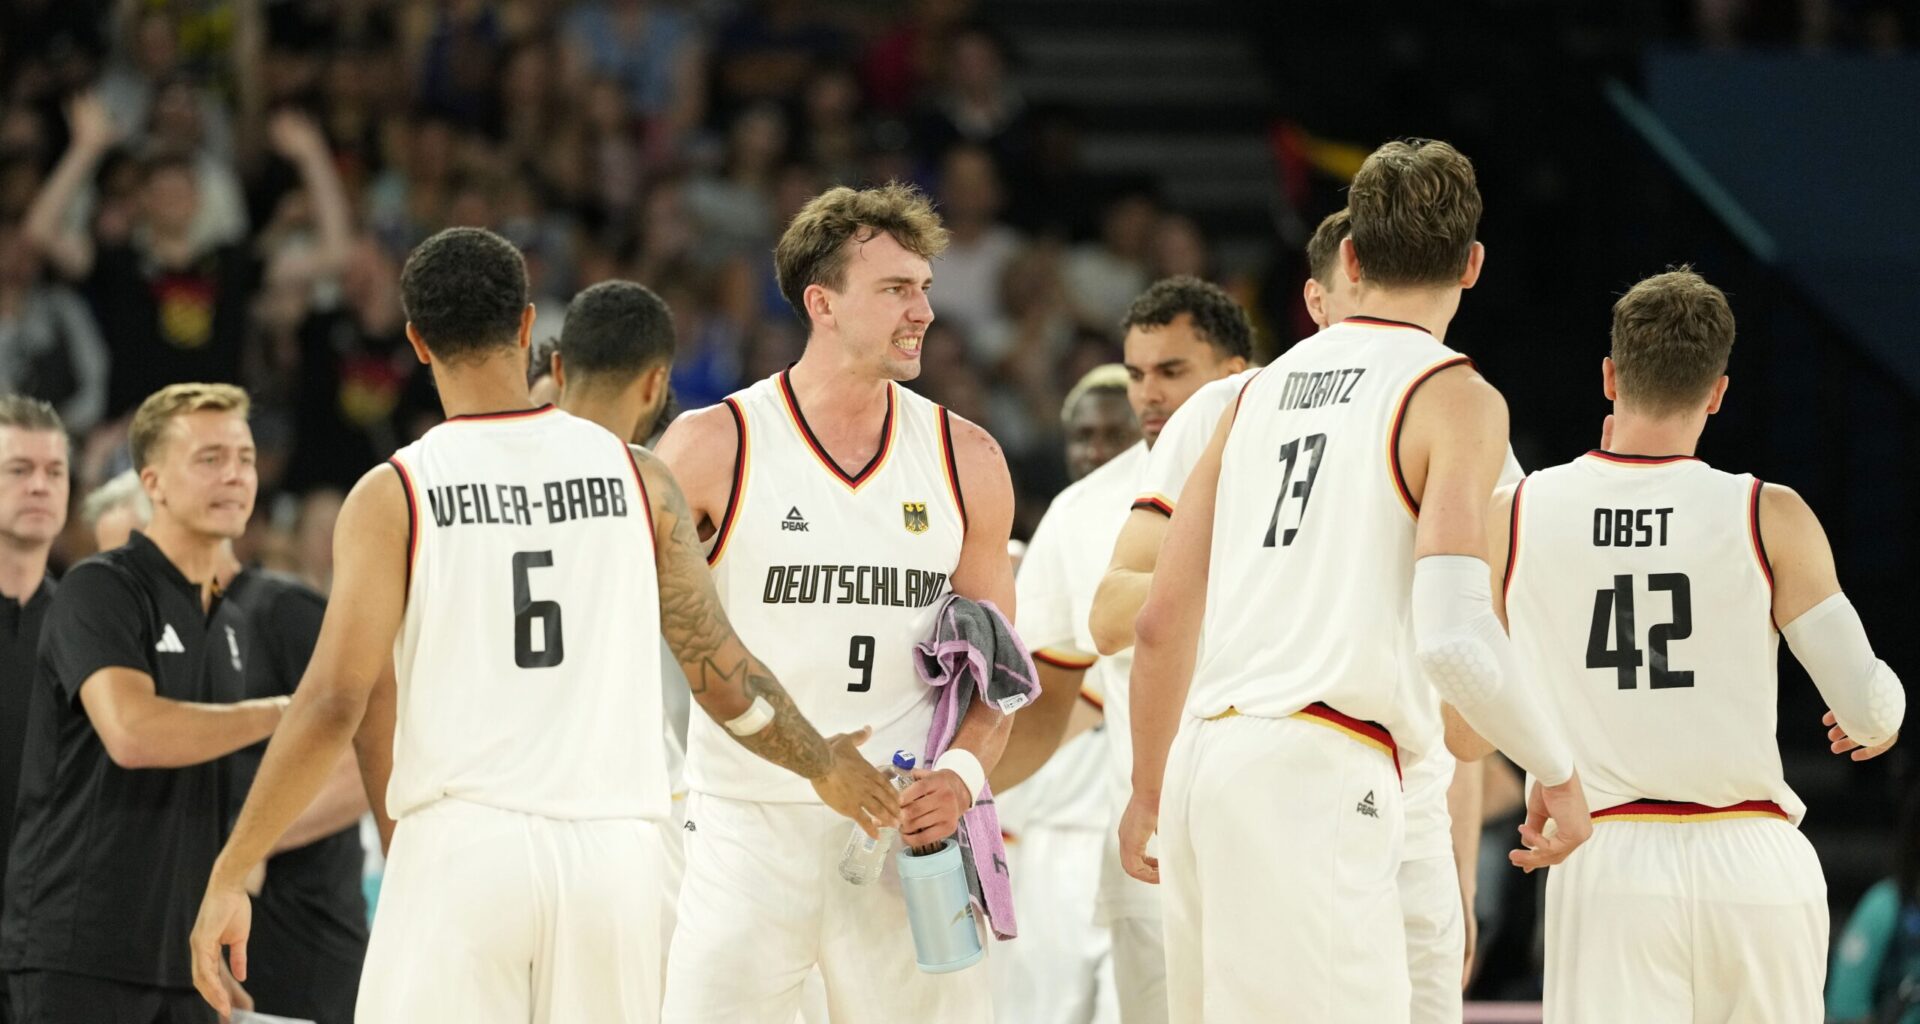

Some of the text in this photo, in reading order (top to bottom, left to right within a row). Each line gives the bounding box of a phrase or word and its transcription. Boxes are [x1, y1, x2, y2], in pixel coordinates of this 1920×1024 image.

[1278, 368, 1366, 411] MORITZ
[427, 477, 628, 528] WEILER-BABB
[1262, 433, 1327, 548] 13
[781, 520, 810, 532] PEAK
[1593, 507, 1674, 547] OBST
[512, 549, 564, 669] 6
[762, 564, 947, 608] DEUTSCHLAND
[1586, 572, 1695, 690] 42
[847, 635, 876, 692] 9
